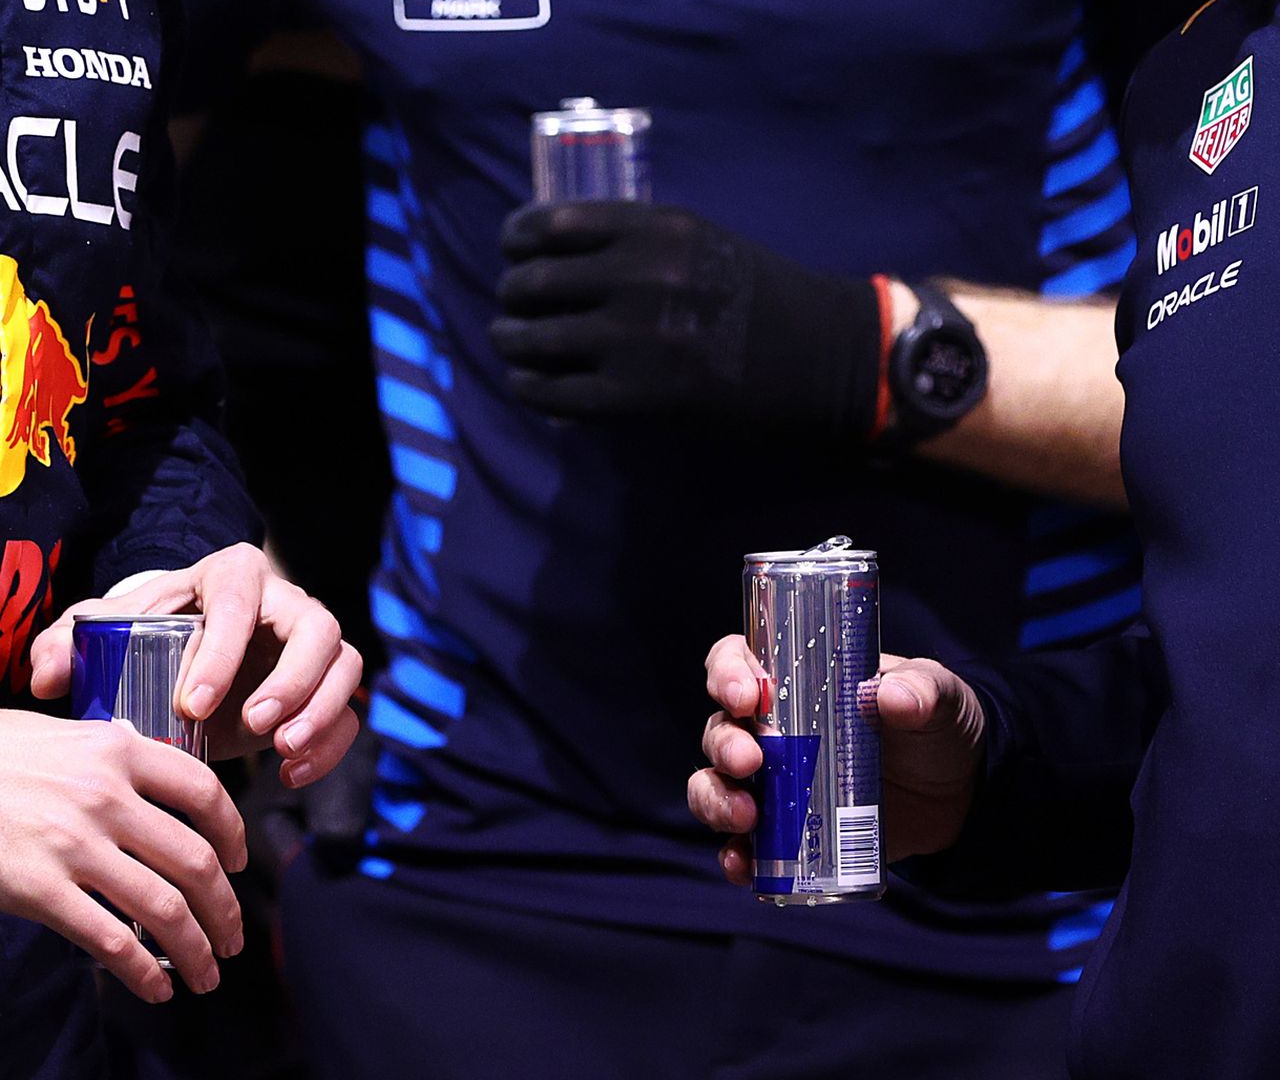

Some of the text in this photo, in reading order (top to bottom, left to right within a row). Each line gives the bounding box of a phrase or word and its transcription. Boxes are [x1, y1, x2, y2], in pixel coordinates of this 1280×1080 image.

[23, 45, 152, 89] HONDA
[1206, 69, 1249, 122] TAG
[1193, 106, 1249, 167] HEUER
[1156, 193, 1249, 276] Mobil 1
[1147, 260, 1243, 331] ORACLE
